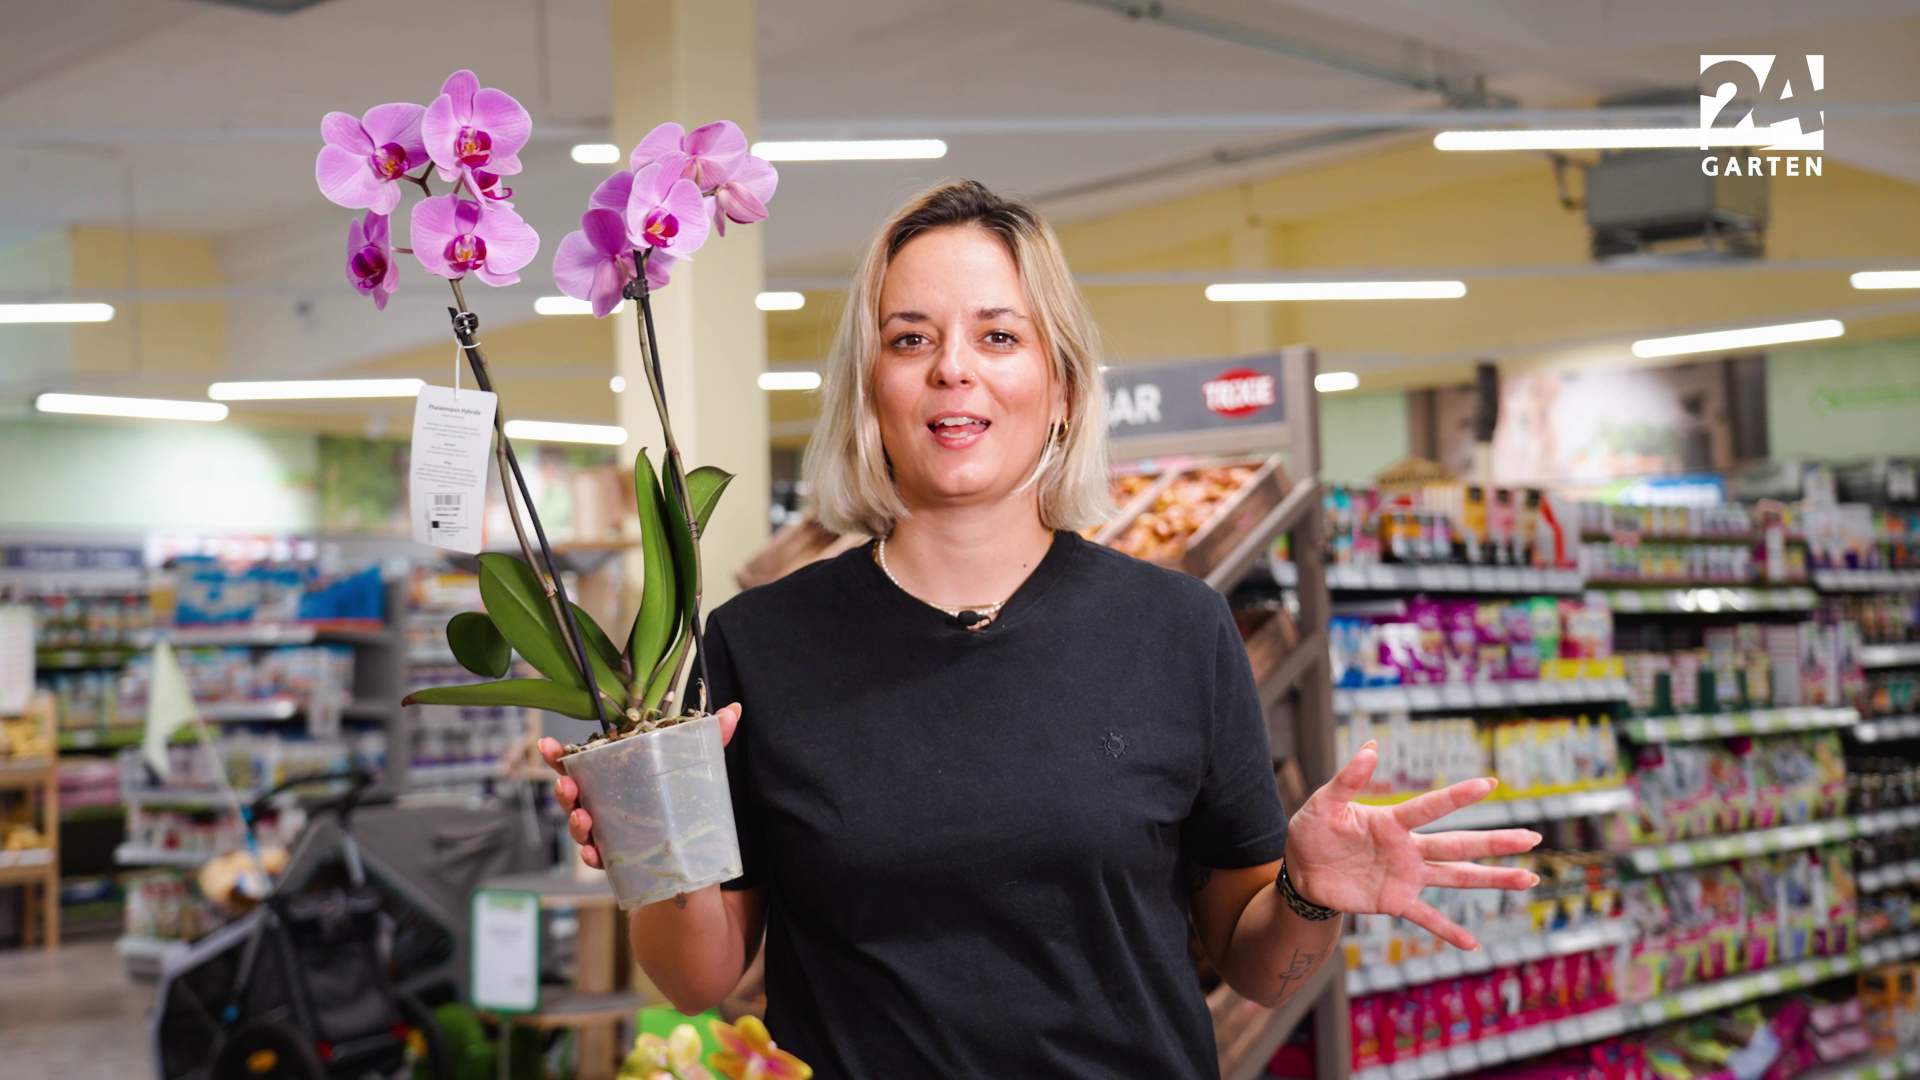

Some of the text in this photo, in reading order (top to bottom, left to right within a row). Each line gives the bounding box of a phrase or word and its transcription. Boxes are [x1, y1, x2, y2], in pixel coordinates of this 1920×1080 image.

[461, 407, 481, 416] Hybride
[1106, 382, 1163, 427] AR
[1202, 373, 1277, 412] TRIXIE
